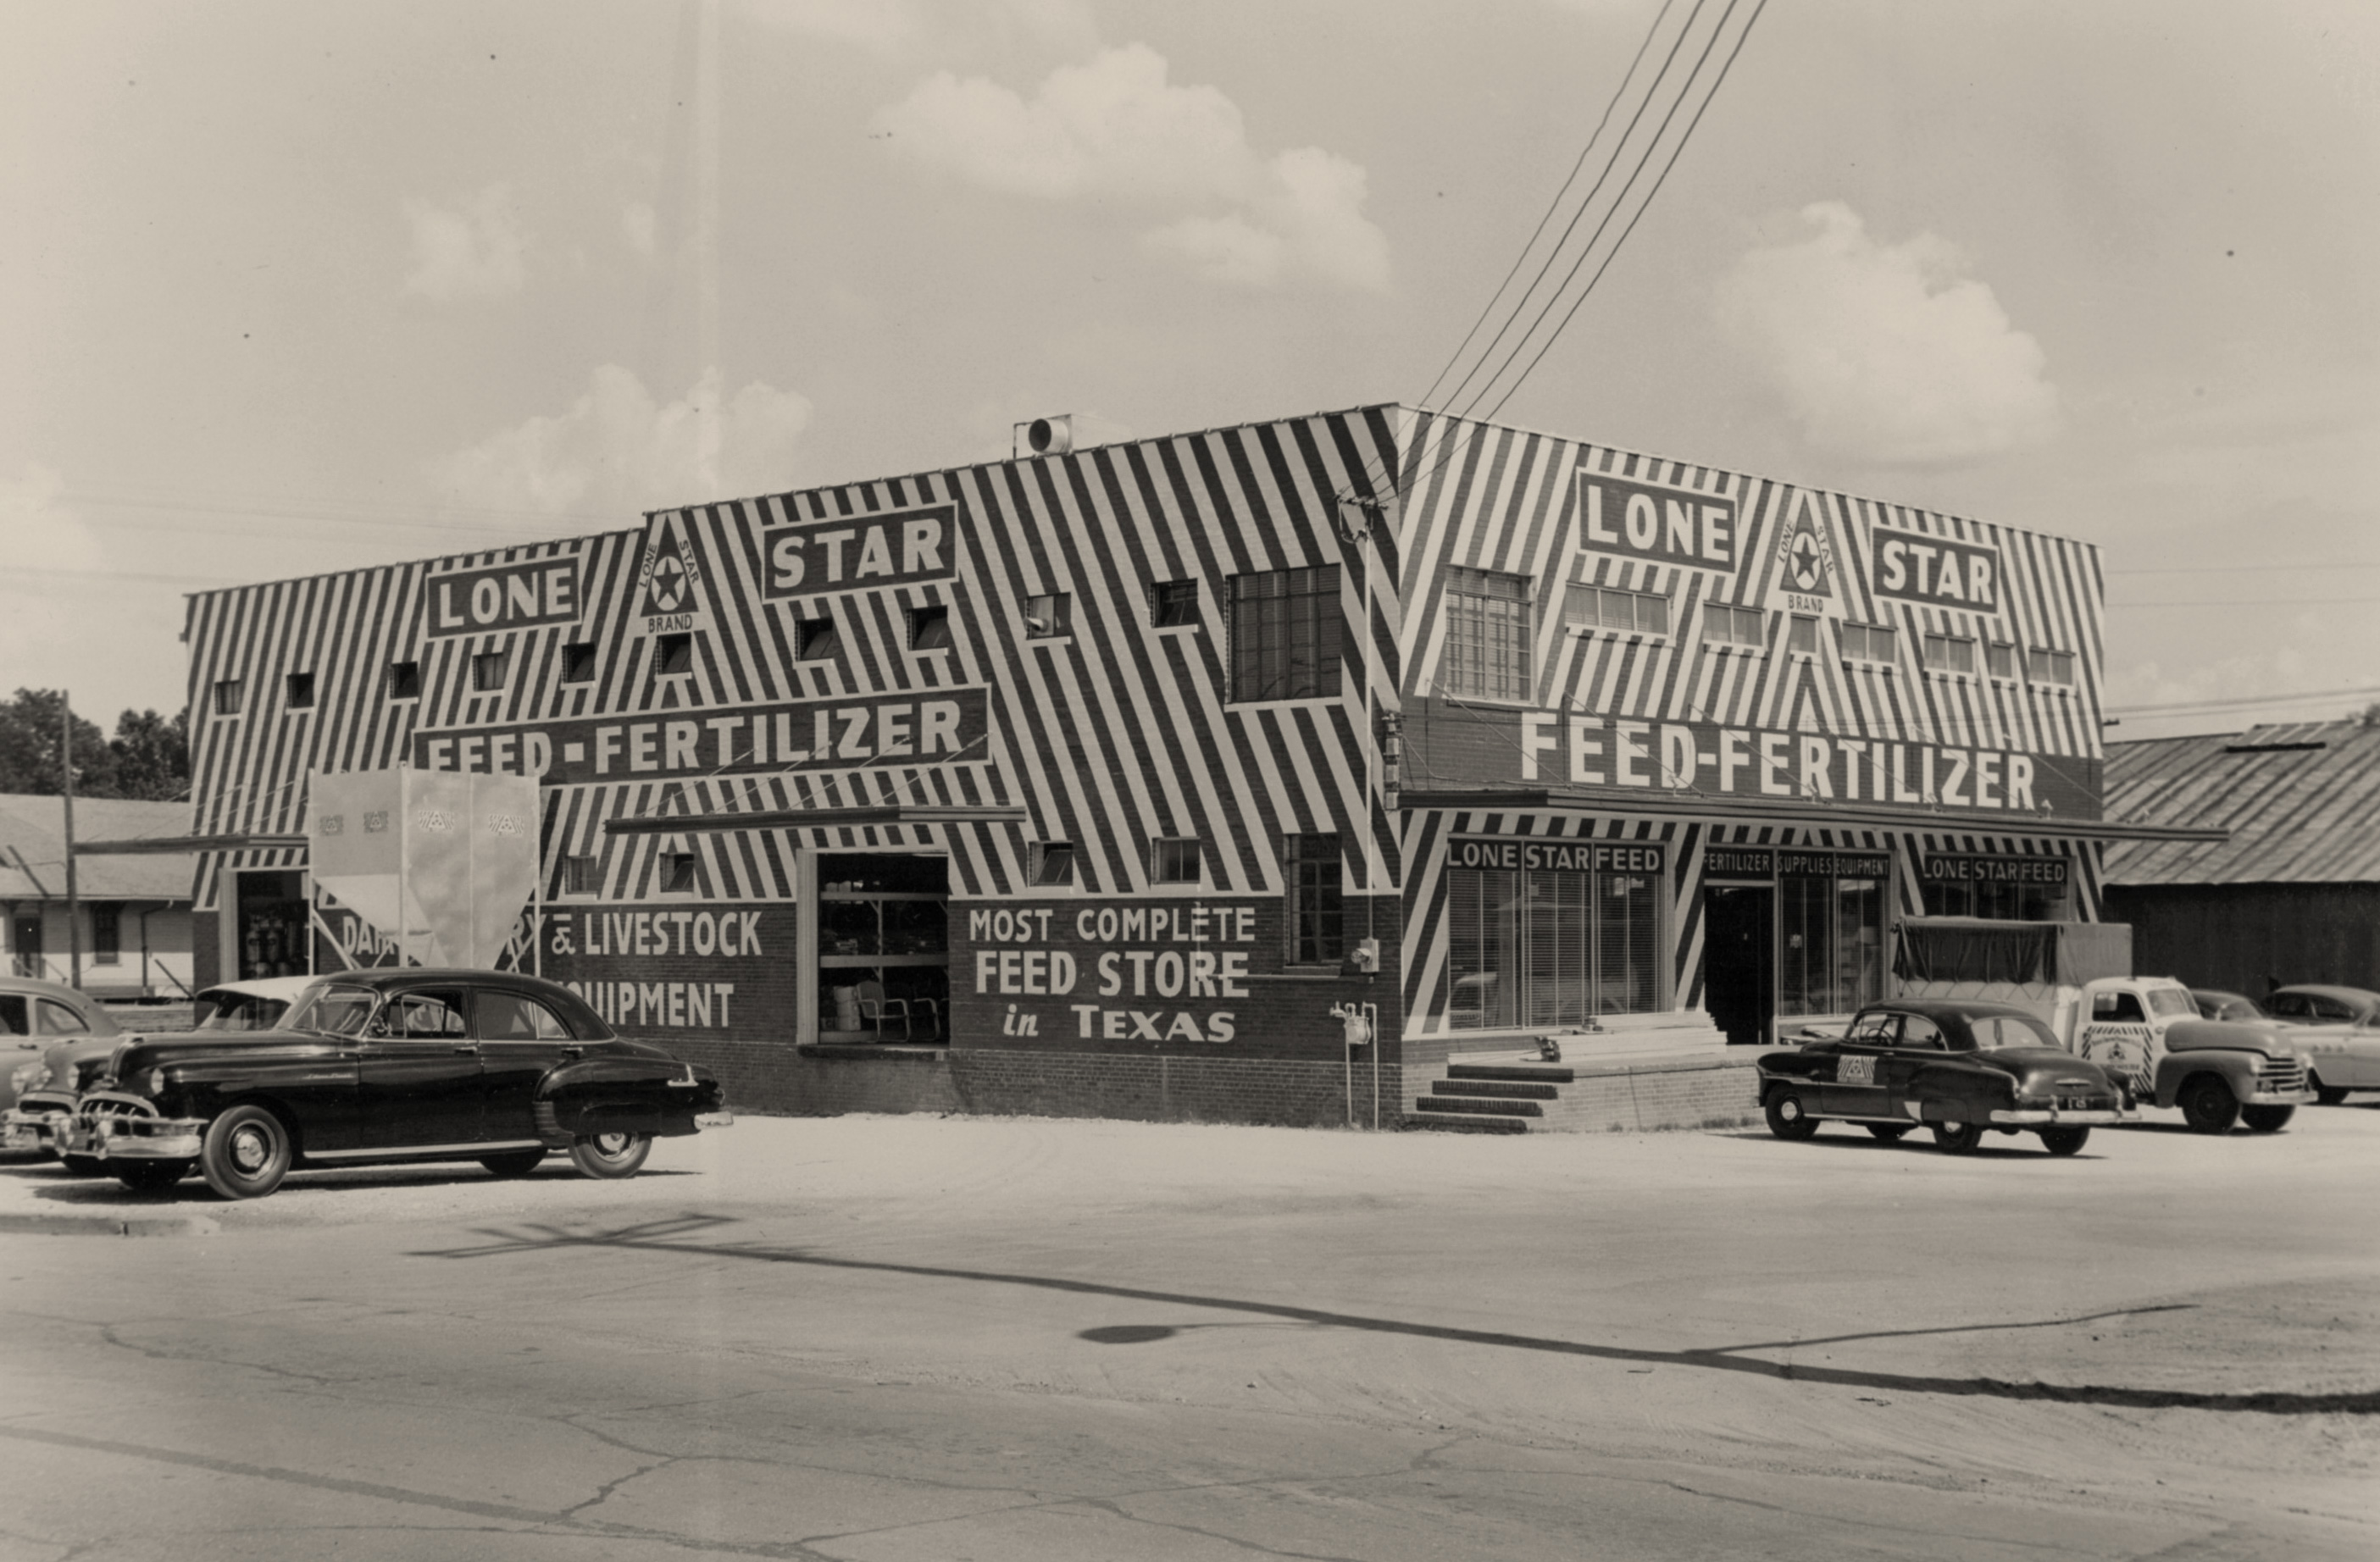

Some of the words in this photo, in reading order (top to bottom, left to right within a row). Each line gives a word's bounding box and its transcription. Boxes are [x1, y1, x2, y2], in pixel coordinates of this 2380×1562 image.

[1588, 485, 1730, 562] LONE
[1778, 519, 1795, 563] LONE
[639, 542, 657, 589] LONE
[680, 540, 700, 584] STAR
[772, 518, 945, 589] STAR
[1817, 525, 1834, 574] STAR
[1883, 540, 1994, 604] STAR
[437, 566, 574, 629] LONE
[1788, 595, 1823, 613] BRAND
[648, 614, 693, 634] BRAND
[1447, 844, 1517, 867] LONE
[1525, 845, 1589, 870] STAR
[1595, 848, 1660, 871] FEED
[1704, 854, 1770, 872] FERTILIZER
[1778, 856, 1832, 874] SUPPLIES
[1836, 858, 1889, 876] EQUIPMENT
[1975, 861, 2018, 880] STAR
[2022, 863, 2065, 882] FEED
[585, 911, 763, 956] LIVESTOCK
[970, 909, 1053, 941] MOST
[1077, 907, 1256, 941] COMPLETE
[976, 950, 1077, 995] FEED
[1098, 951, 1250, 998] STORE
[557, 981, 734, 1027] UIPMENT
[1003, 1004, 1039, 1037] in
[1071, 1005, 1235, 1043] TEXAS
